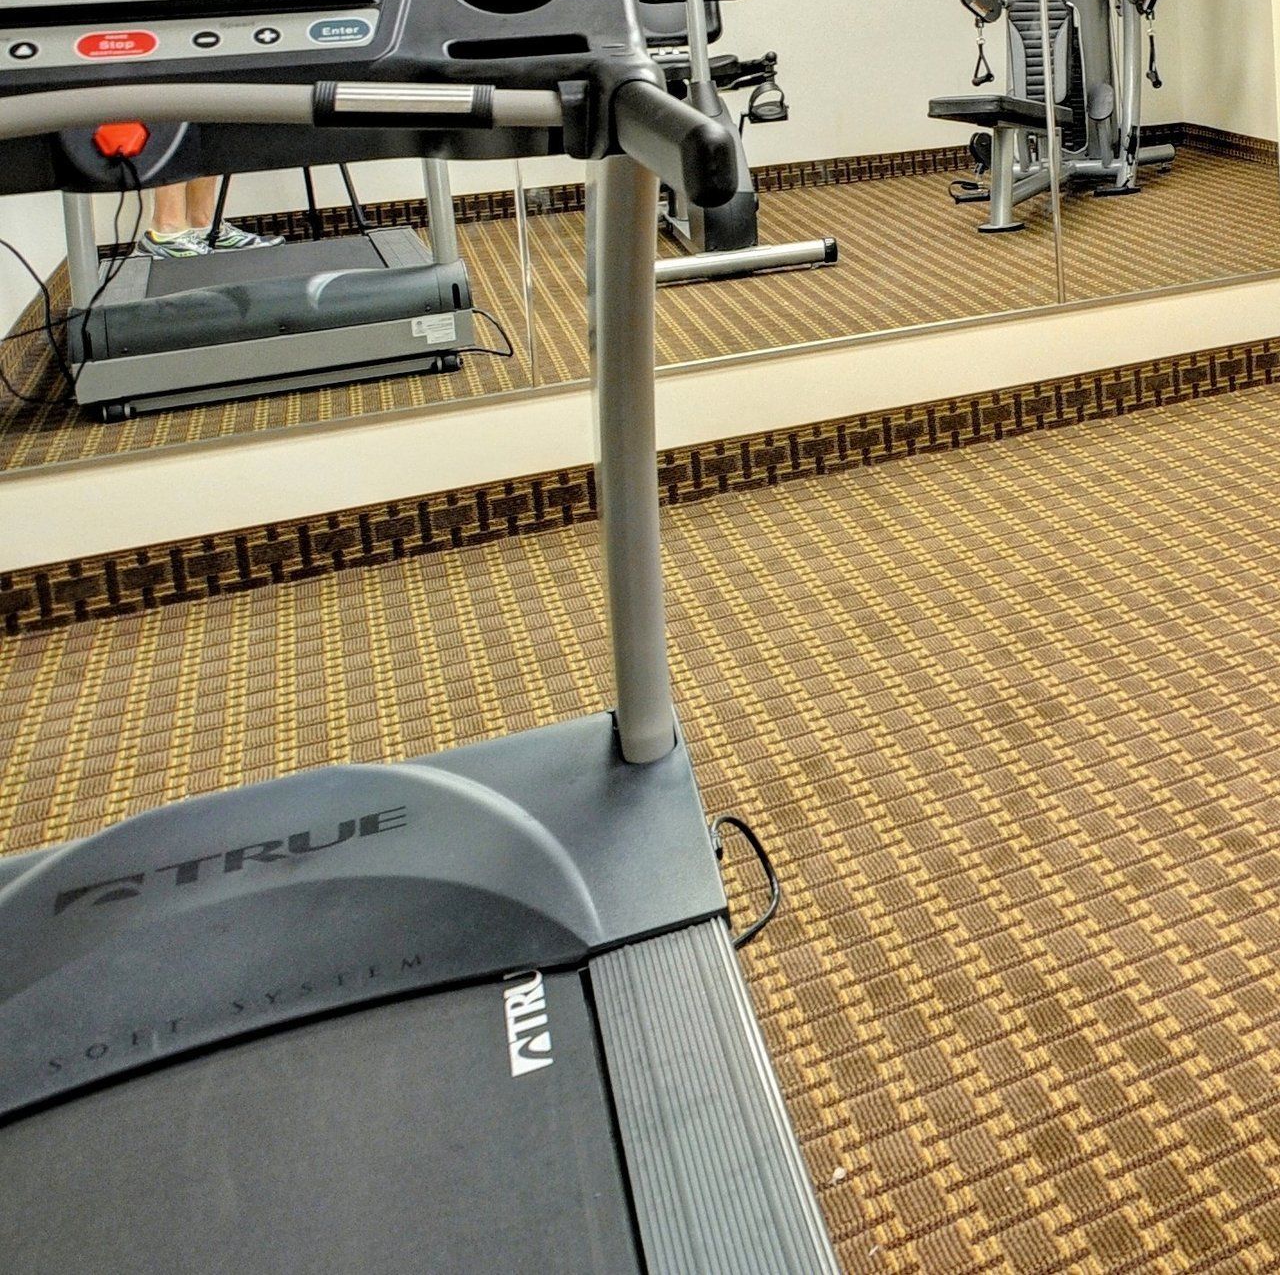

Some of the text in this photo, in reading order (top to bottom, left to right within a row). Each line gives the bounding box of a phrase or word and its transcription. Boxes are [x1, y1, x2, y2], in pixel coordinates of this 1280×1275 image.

[98, 39, 136, 51] Stop
[322, 26, 360, 37] Enter
[155, 805, 407, 886] TRUE
[503, 970, 549, 1044] TRU
